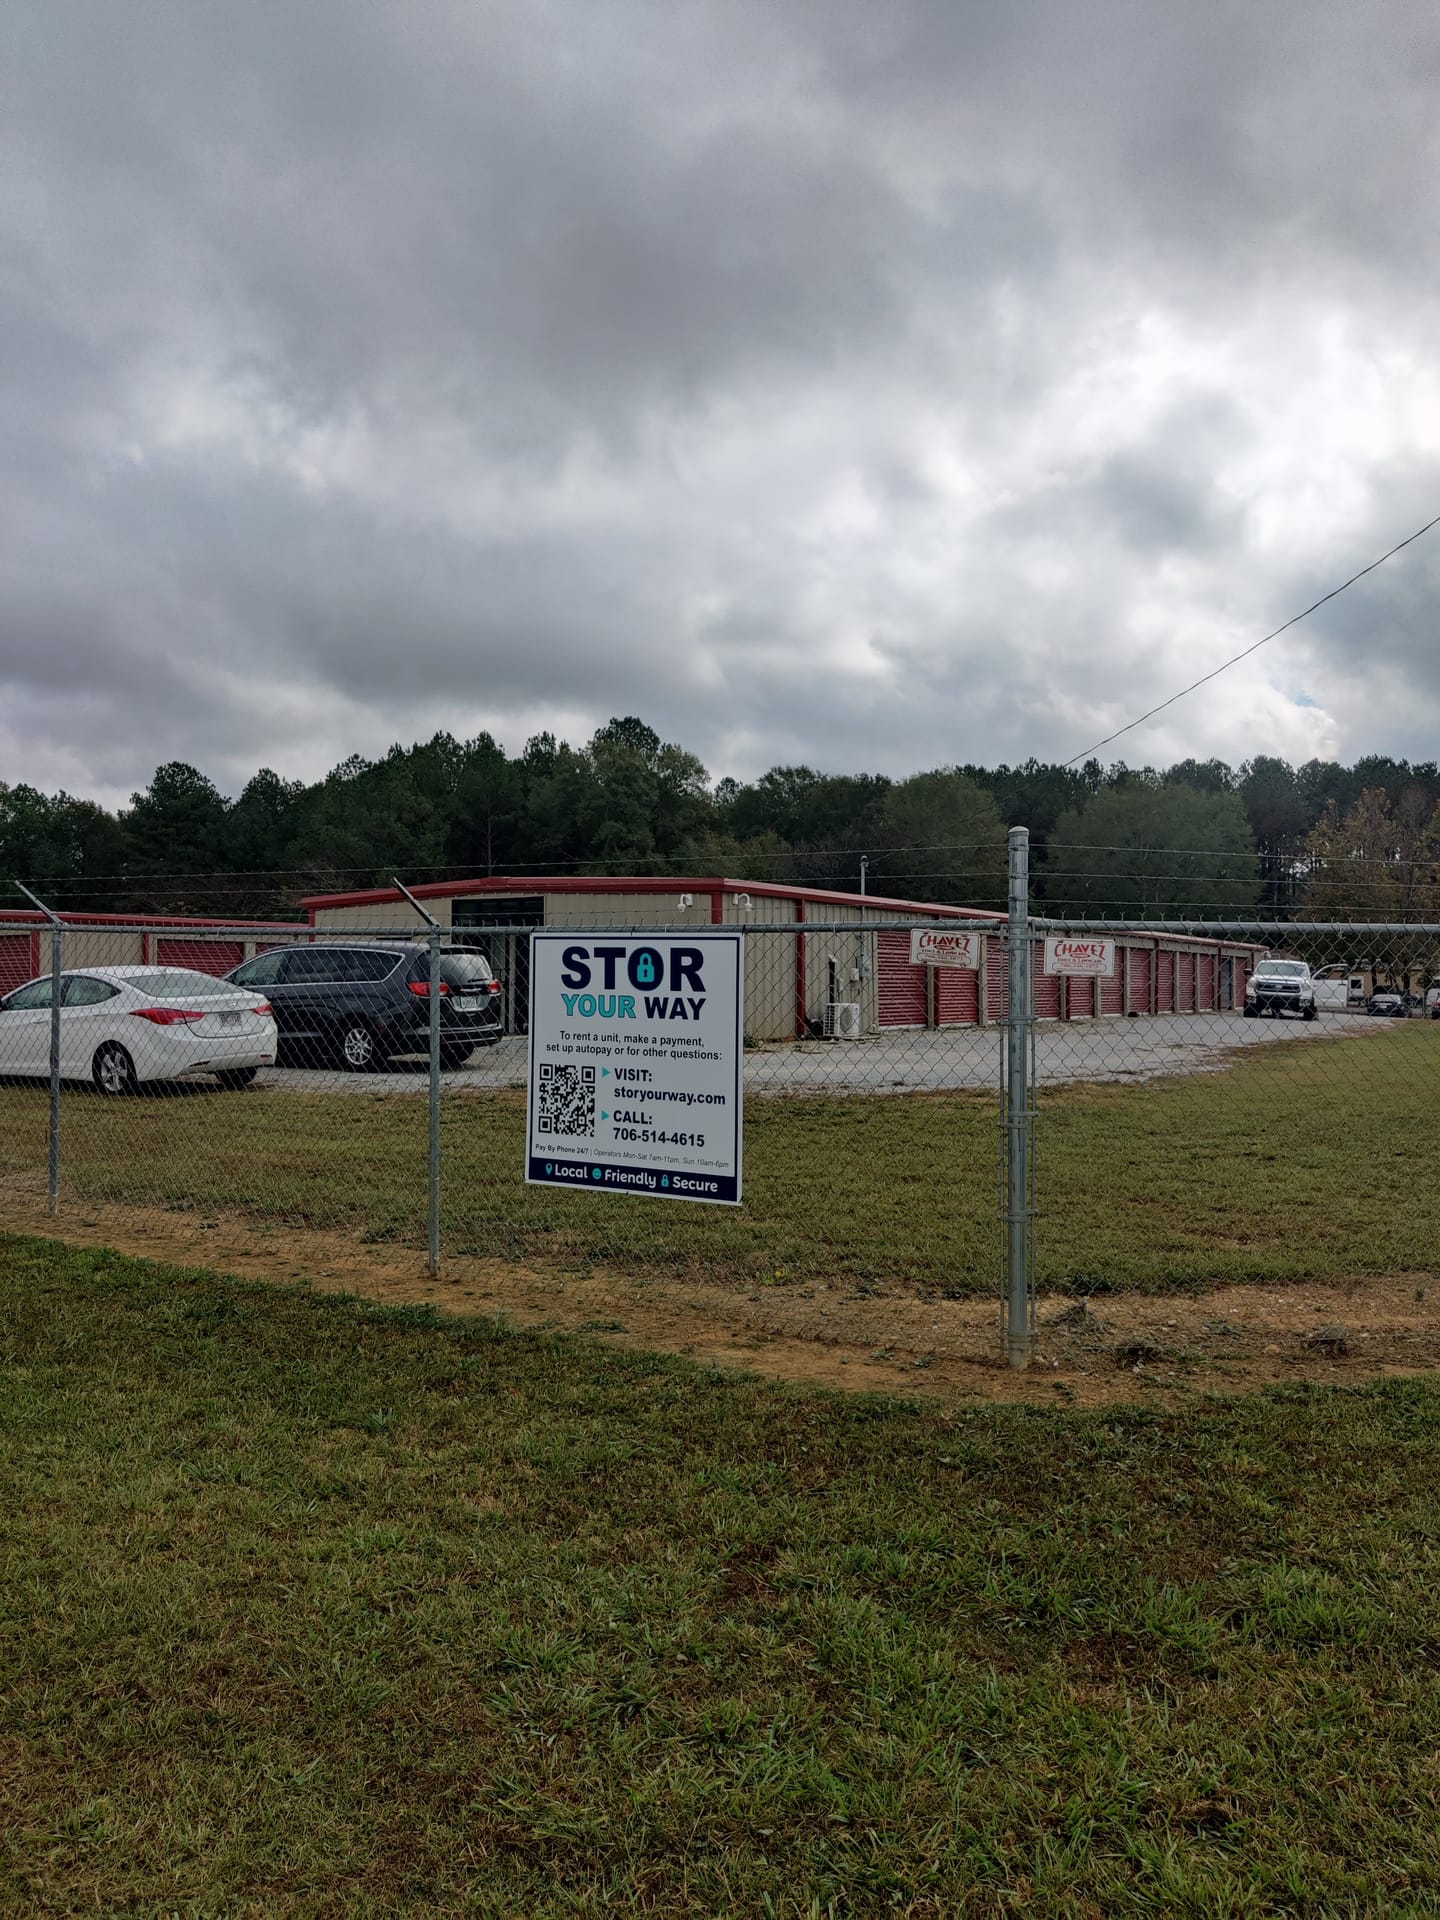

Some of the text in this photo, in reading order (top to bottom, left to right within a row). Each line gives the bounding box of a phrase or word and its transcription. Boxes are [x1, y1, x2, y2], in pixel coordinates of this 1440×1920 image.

[919, 934, 970, 953] CHAVEZ
[1054, 943, 1106, 960] CHAVEZ
[561, 946, 706, 992] STOR
[561, 993, 706, 1020] YOUR WAY
[560, 1031, 704, 1048] To rent a unit, make a payment,
[546, 1043, 723, 1060] set up autopay or for other questions:
[614, 1068, 652, 1082] VISIT:
[614, 1086, 726, 1106] storyourway.com
[613, 1110, 653, 1125] CALL:
[613, 1127, 705, 1147] 706-514-4615
[535, 1143, 546, 1152] Pay
[557, 1145, 575, 1154] Phone
[683, 1156, 695, 1165] Sun
[555, 1163, 719, 1192] Local Friendly Secure
